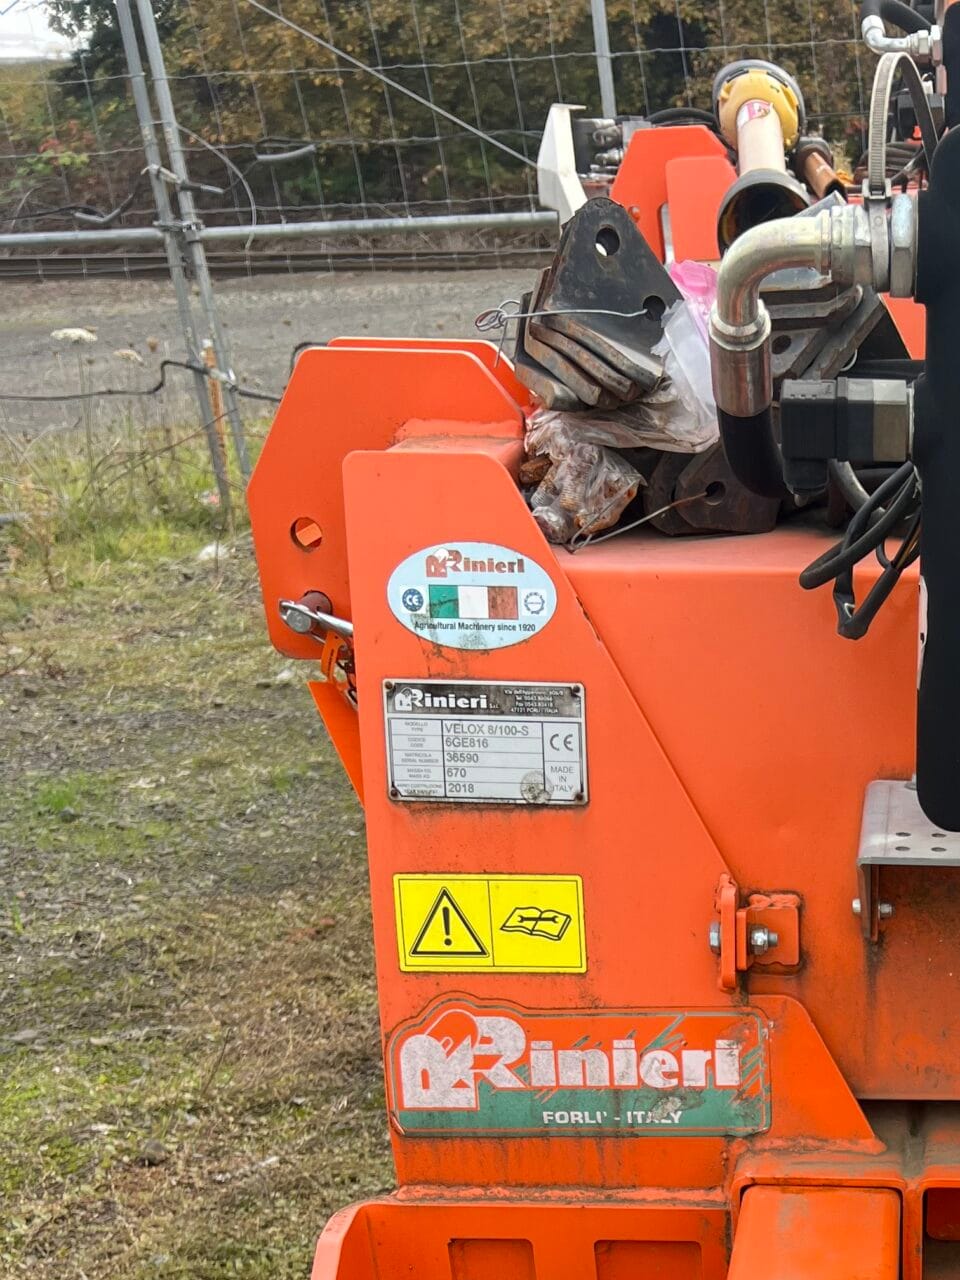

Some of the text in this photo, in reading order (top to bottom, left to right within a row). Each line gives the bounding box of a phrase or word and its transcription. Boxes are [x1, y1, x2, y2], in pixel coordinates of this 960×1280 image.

[446, 549, 525, 574] Rinieri
[414, 621, 456, 631] Agricultural
[458, 622, 495, 632] Machinery
[497, 623, 517, 631] since
[411, 688, 487, 709] Rinieri
[445, 723, 529, 735] VELOX 8/100-S
[445, 737, 489, 748] 6GE816
[446, 768, 466, 778] 670
[448, 783, 475, 793] 2018
[472, 1016, 741, 1088] Rinieri
